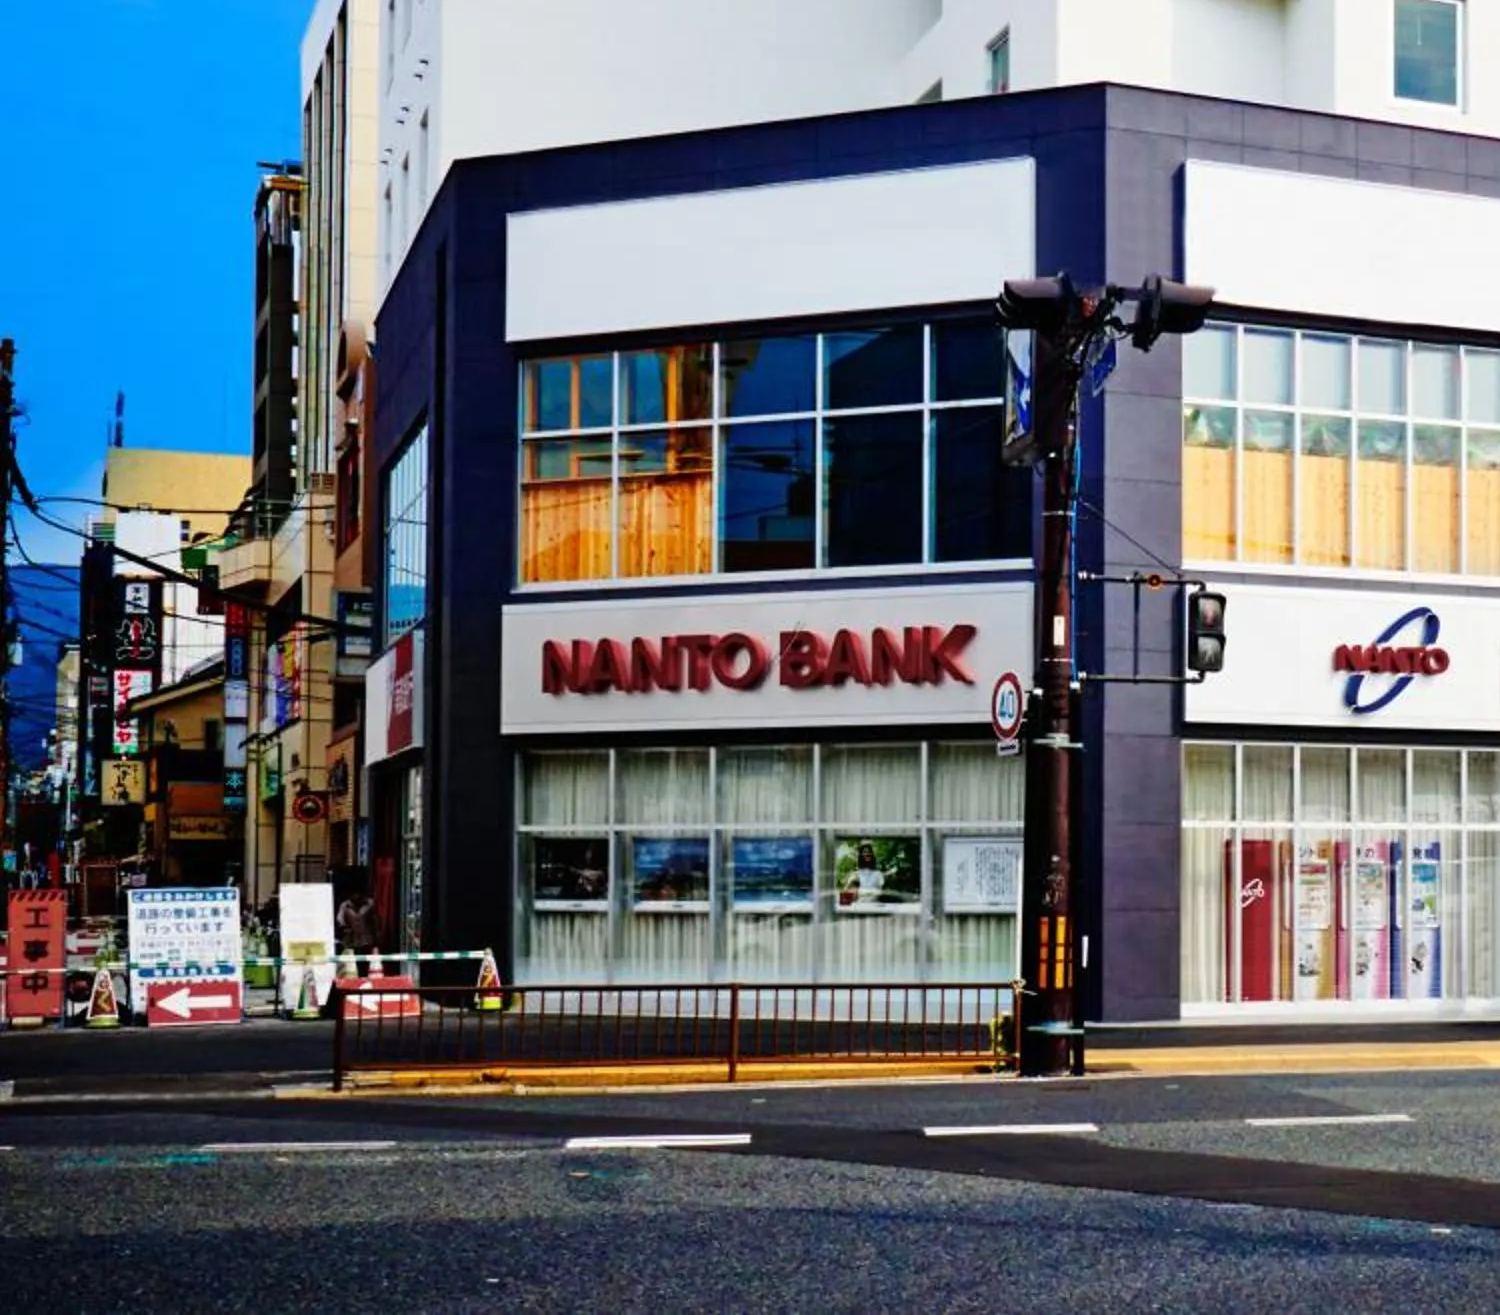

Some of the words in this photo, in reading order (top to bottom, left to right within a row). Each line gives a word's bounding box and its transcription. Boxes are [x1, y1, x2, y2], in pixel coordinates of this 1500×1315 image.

[541, 633, 769, 695] NANTO
[779, 623, 977, 688] BANK
[1332, 642, 1451, 677] NANTO
[998, 689, 1015, 720] 40
[21, 907, 50, 996] 工事中
